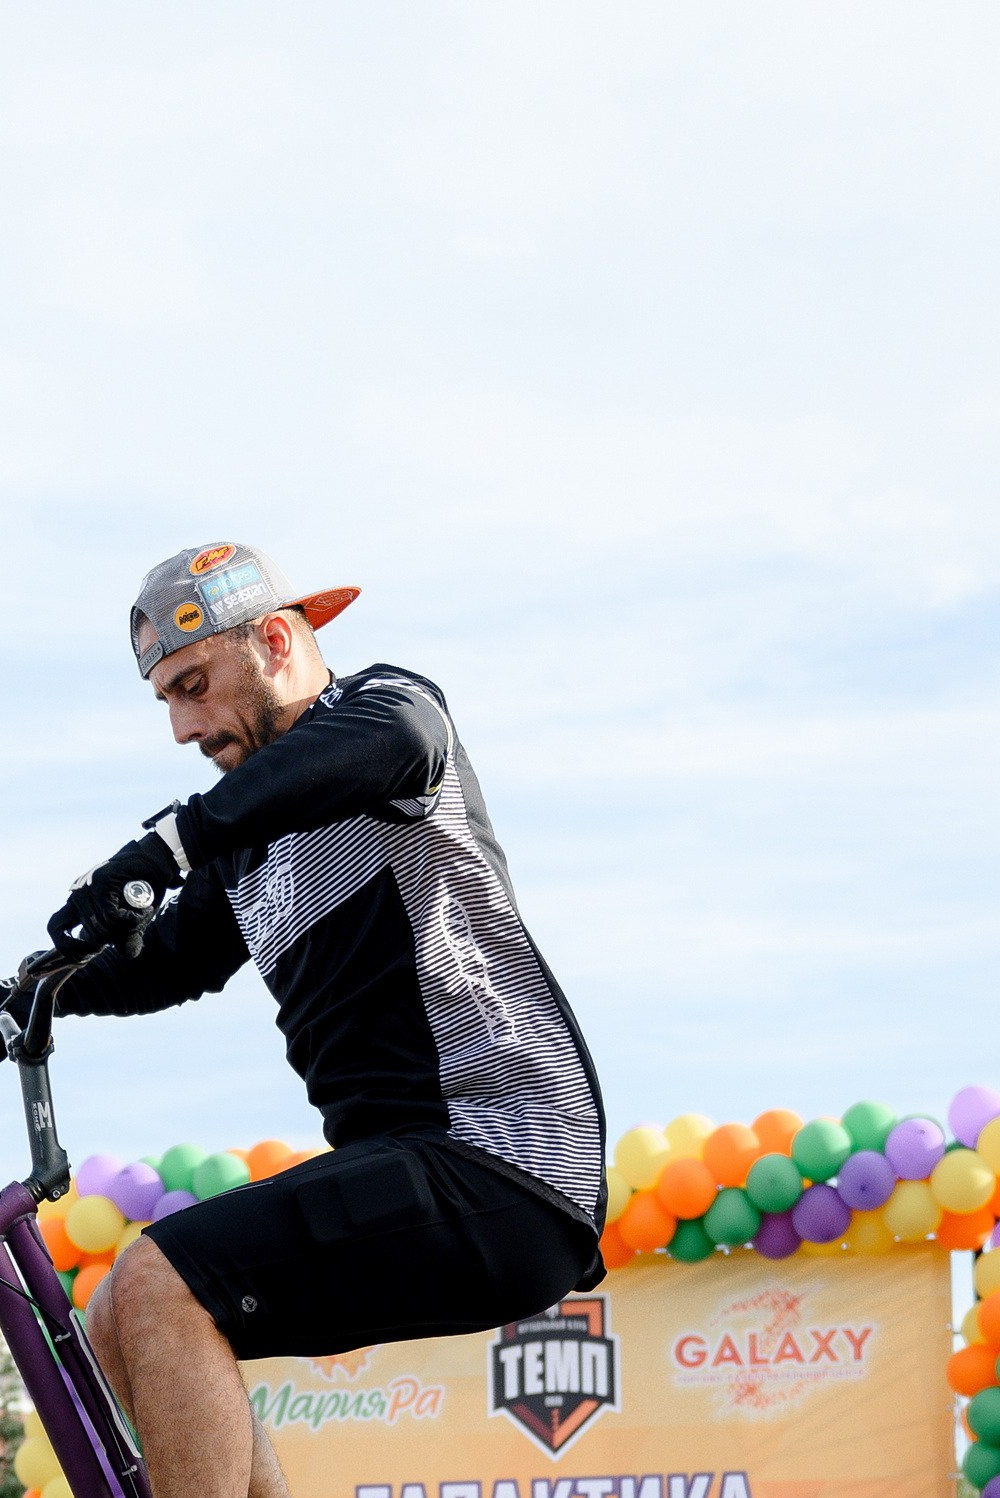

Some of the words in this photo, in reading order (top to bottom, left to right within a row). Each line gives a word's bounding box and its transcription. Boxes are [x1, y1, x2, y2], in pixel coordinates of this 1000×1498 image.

[223, 582, 267, 609] seaspan
[674, 1328, 873, 1369] GALAXY
[499, 1340, 608, 1400] ТЕМП
